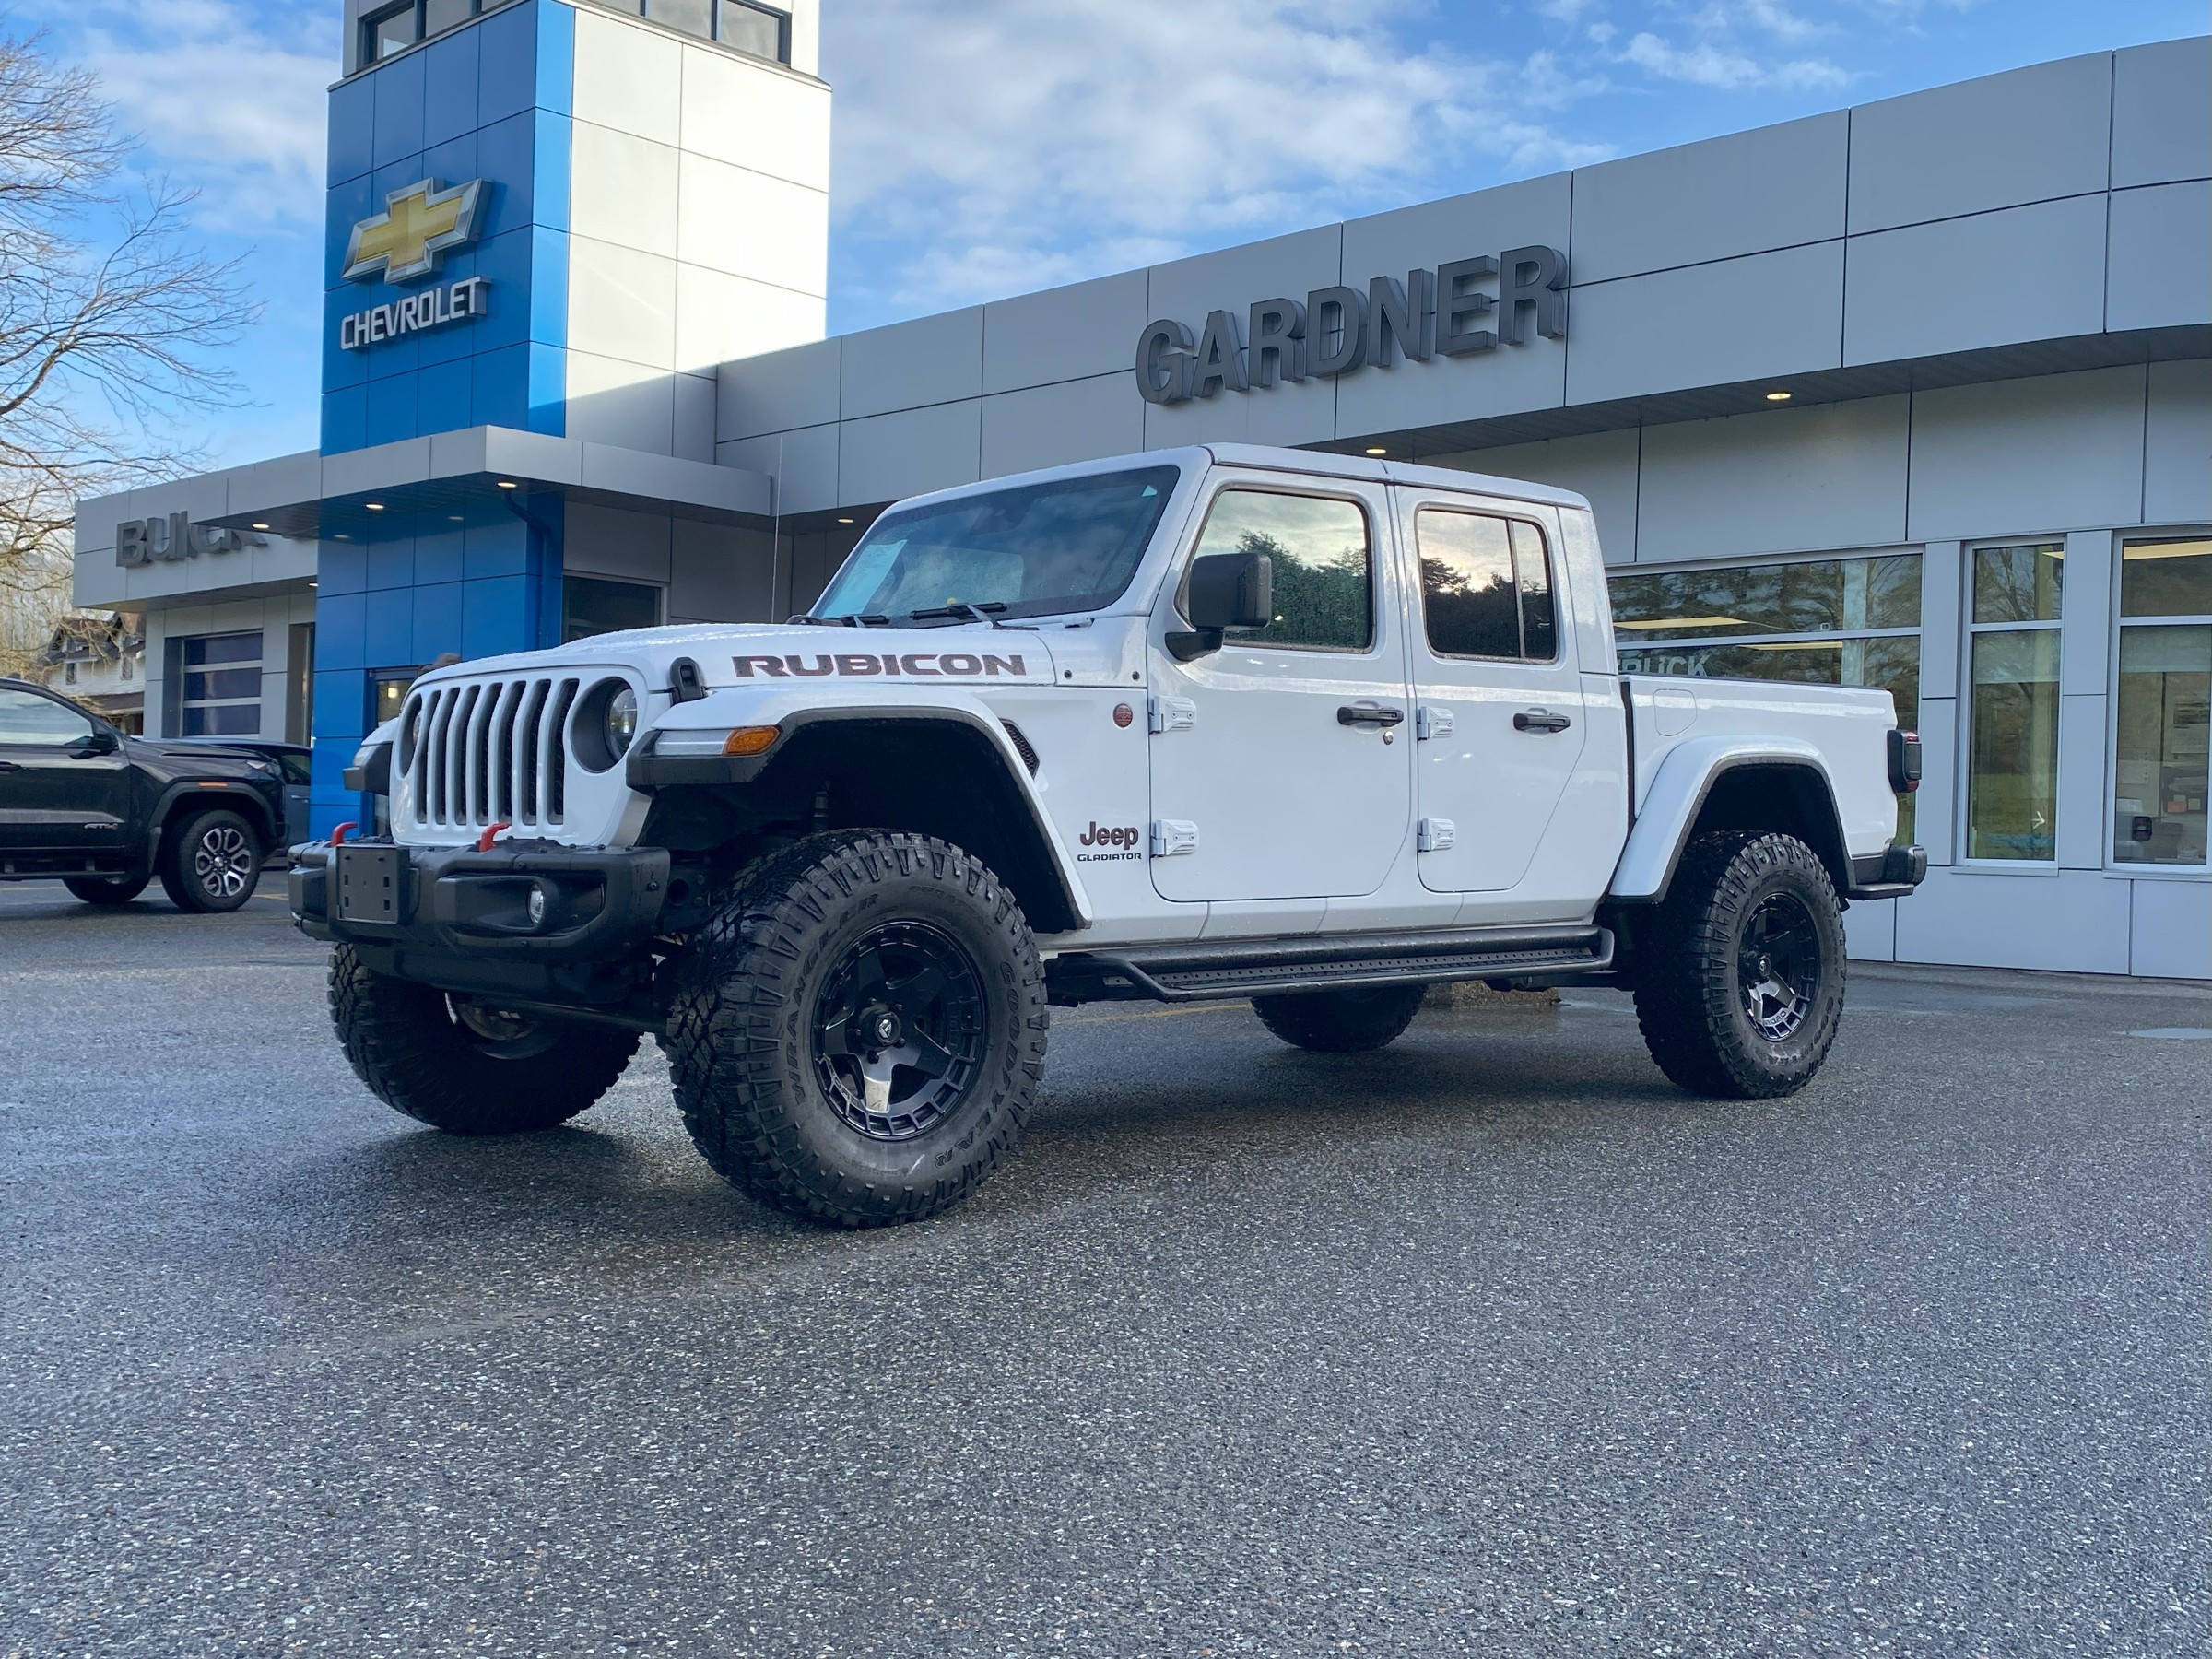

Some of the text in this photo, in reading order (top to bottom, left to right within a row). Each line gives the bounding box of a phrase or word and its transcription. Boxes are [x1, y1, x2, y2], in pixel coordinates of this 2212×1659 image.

[341, 276, 488, 350] CHEVROLET
[1135, 244, 1565, 405] GARDNER
[731, 654, 1027, 677] RUBICON
[1079, 820, 1139, 851] Jeep
[1077, 853, 1142, 862] GLADIATOR
